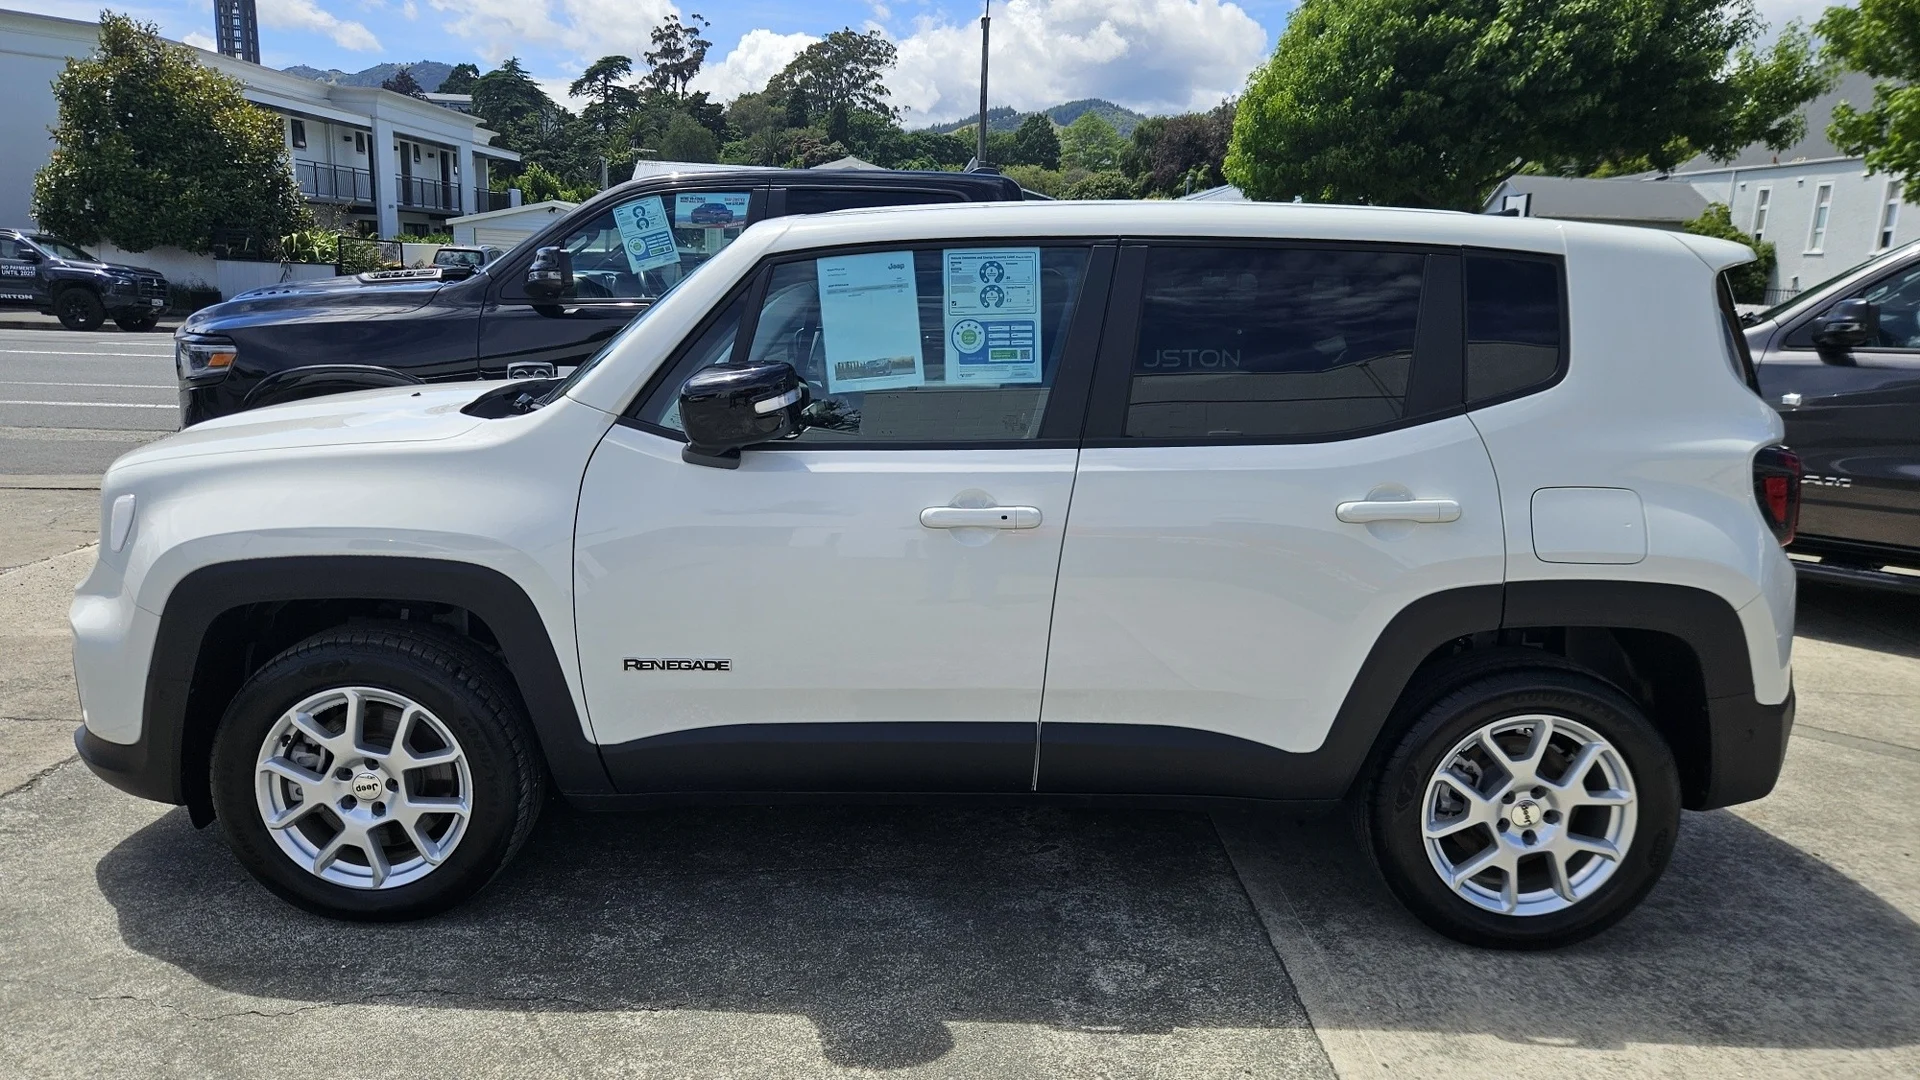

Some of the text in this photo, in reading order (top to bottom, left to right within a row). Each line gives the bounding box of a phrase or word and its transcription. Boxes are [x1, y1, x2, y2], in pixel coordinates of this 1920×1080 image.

[888, 263, 905, 271] Jeep
[623, 658, 731, 672] RENEGADE
[355, 782, 379, 792] Jeep
[1521, 804, 1533, 825] Jeep
